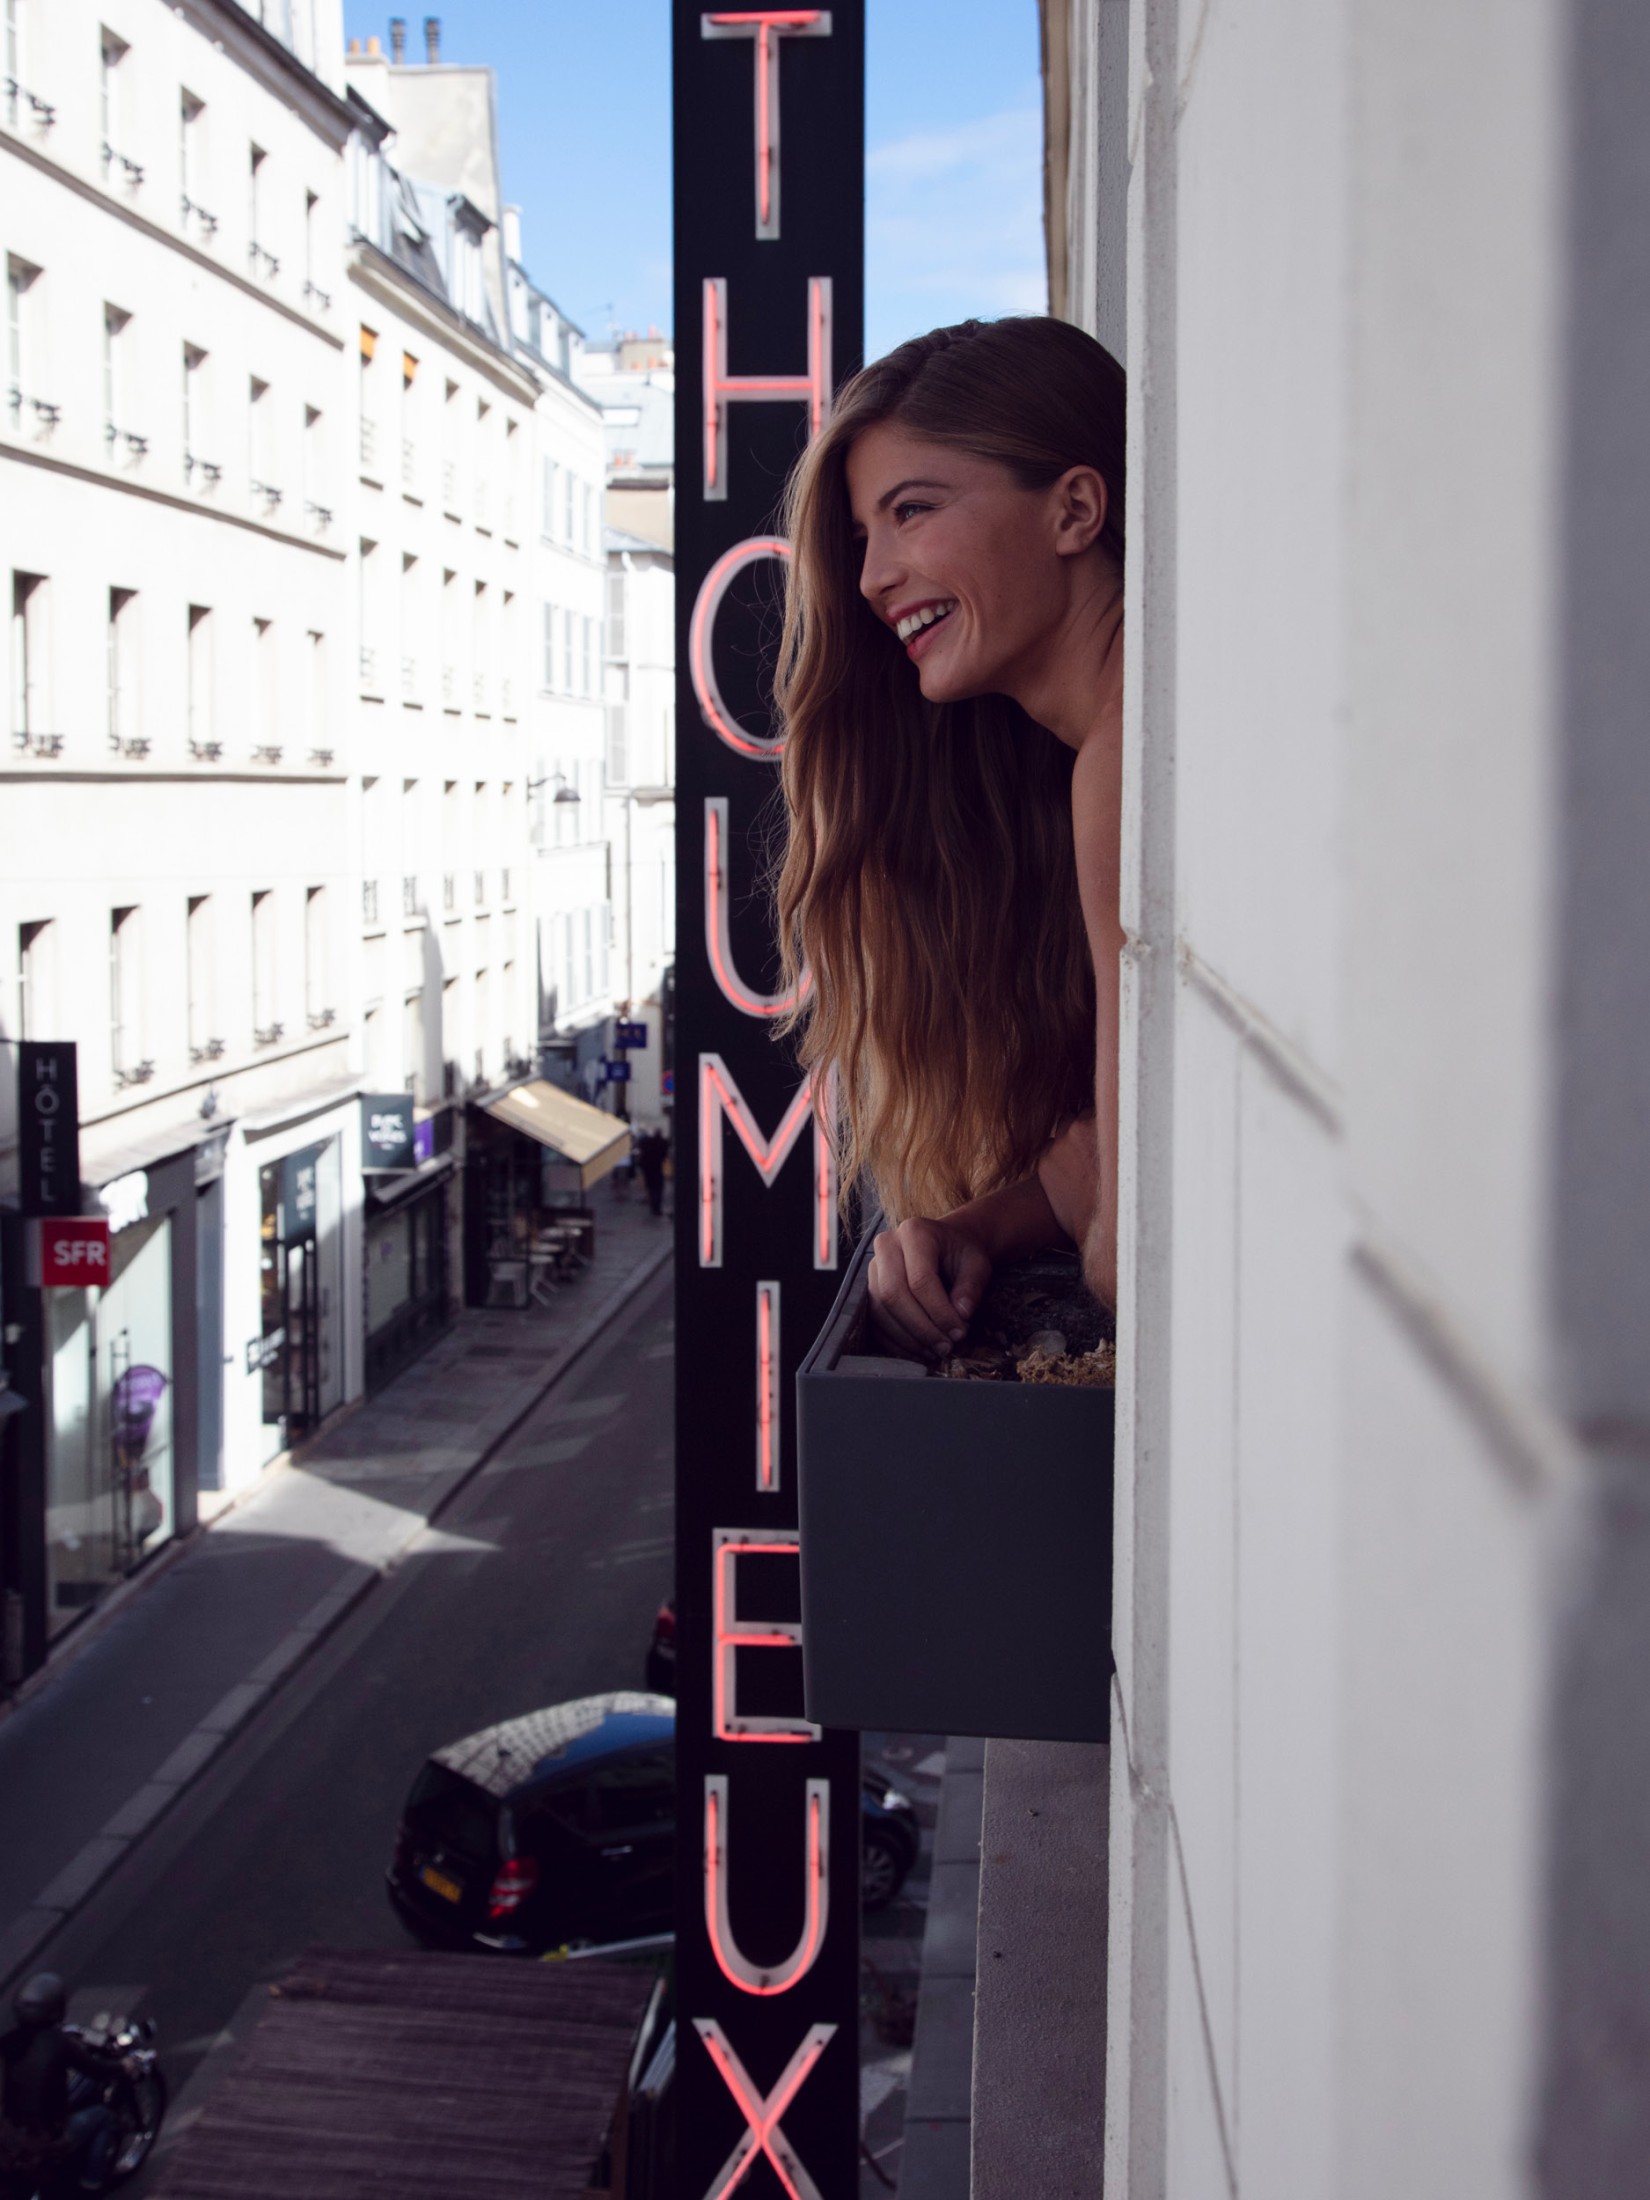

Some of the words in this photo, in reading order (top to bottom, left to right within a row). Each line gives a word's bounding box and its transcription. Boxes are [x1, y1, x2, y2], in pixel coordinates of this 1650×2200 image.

[35, 1057, 59, 1202] HÔTEL
[691, 10, 839, 2200] THOUMIEUX
[54, 1240, 106, 1266] SFR
